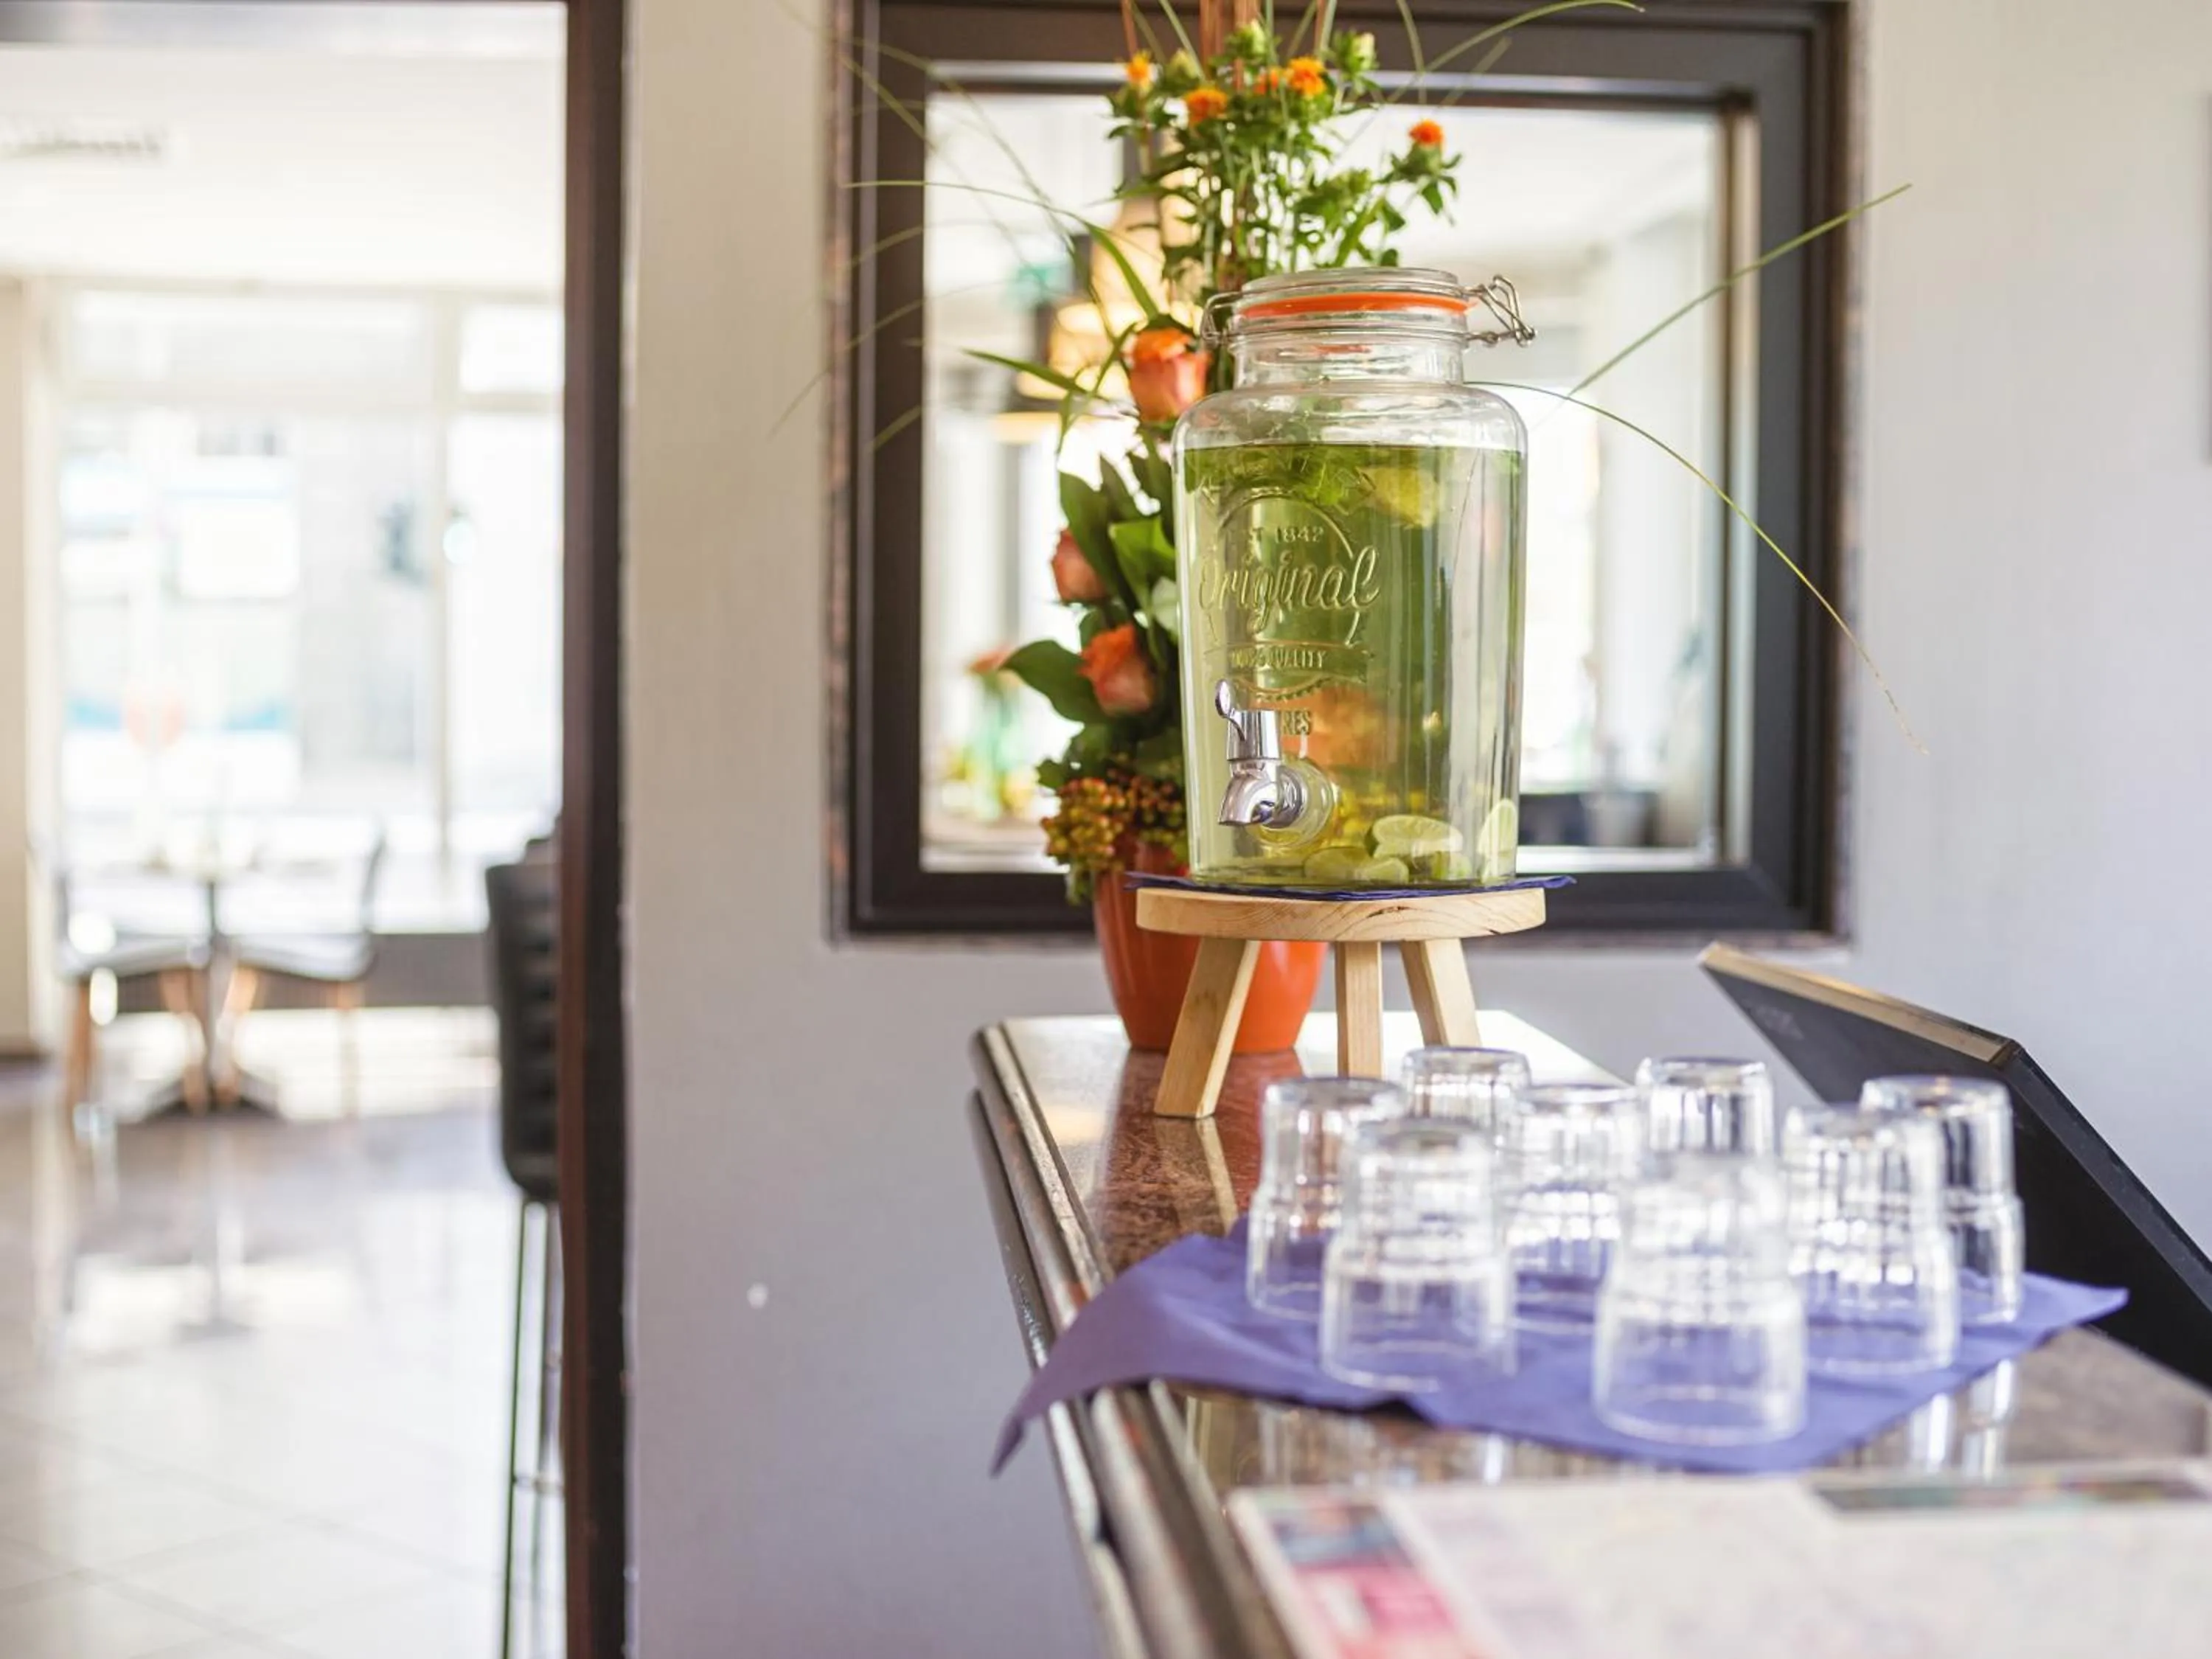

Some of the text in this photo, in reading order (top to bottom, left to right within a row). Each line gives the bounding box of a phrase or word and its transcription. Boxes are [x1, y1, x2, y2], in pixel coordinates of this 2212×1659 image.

[1275, 525, 1326, 543] 1842
[1198, 545, 1381, 635] Original
[1281, 709, 1313, 736] RES
